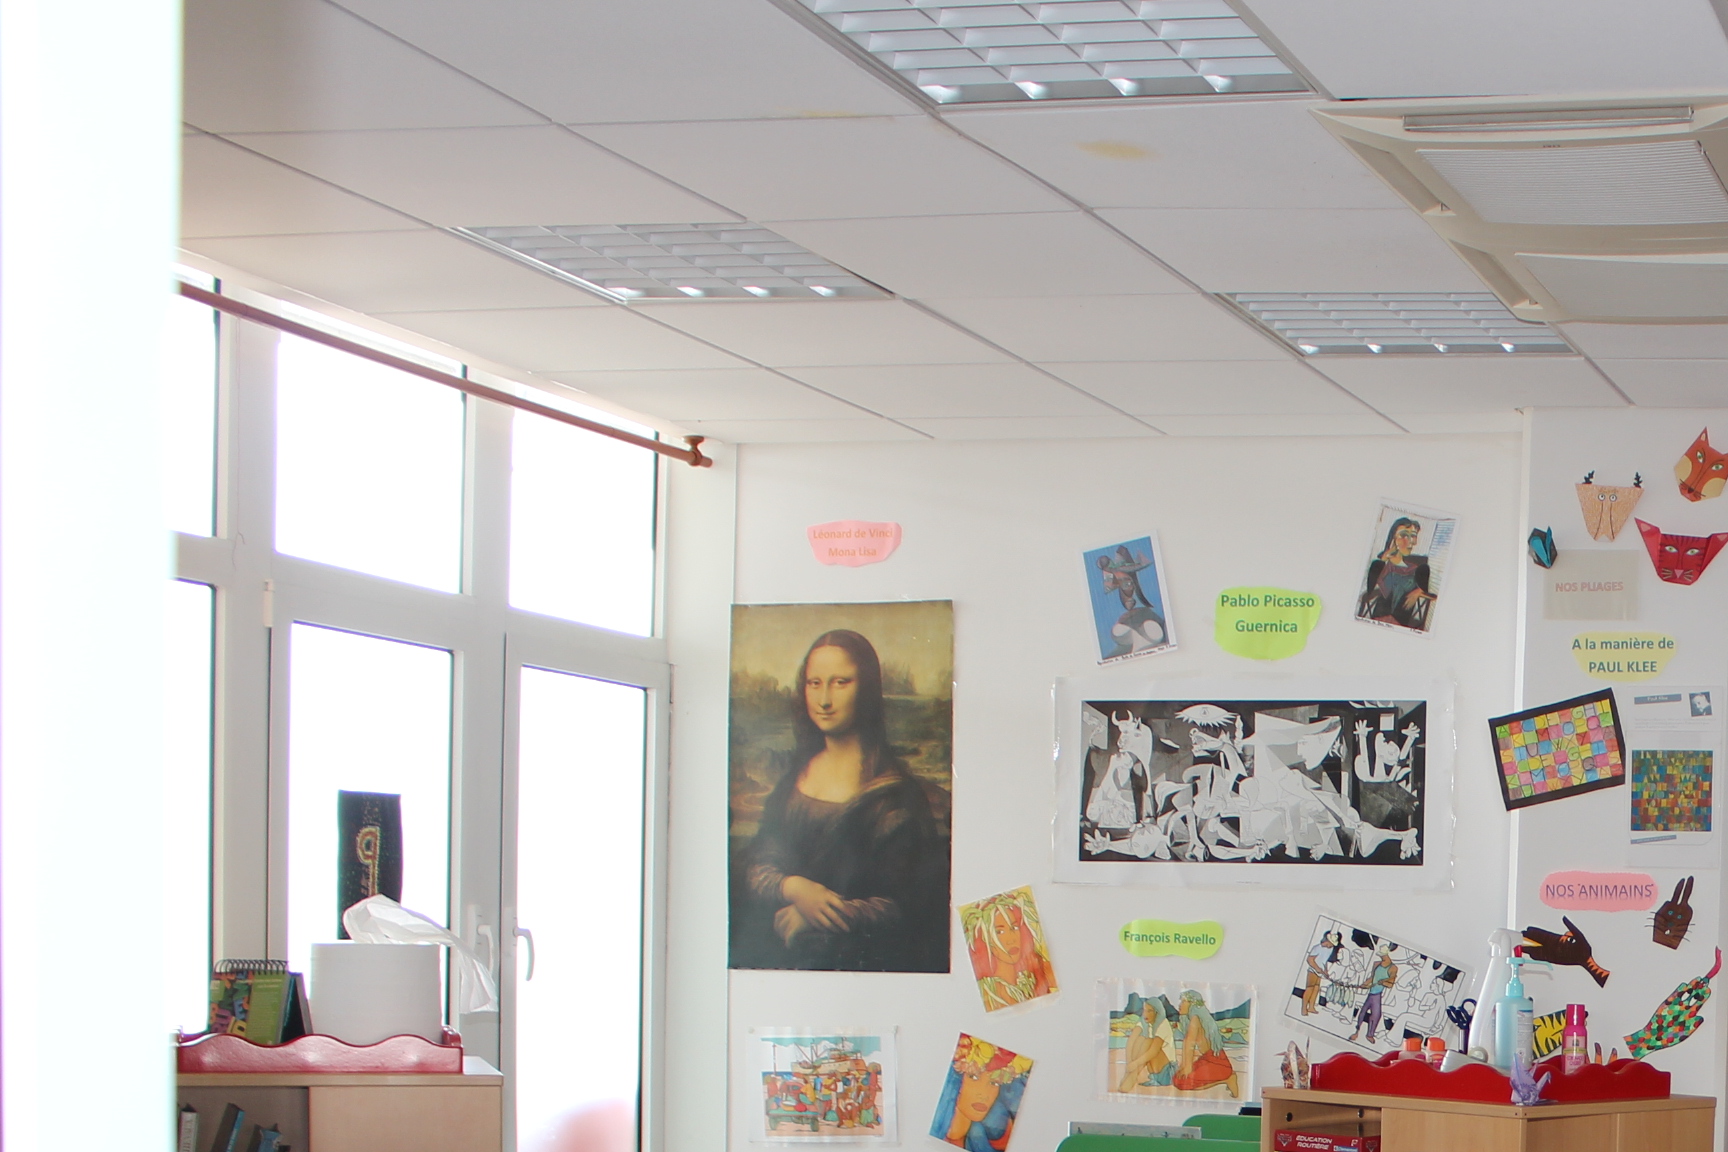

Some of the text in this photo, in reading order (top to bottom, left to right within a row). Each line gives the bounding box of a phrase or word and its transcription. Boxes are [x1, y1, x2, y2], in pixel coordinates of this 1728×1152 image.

[813, 528, 893, 539] Léonard de Vinci
[828, 547, 877, 557] Mona Lisa
[1555, 581, 1624, 592] NOS PLIAGES
[1221, 594, 1315, 608] Pablo Picasso
[1235, 619, 1298, 633] Guernica
[1572, 637, 1675, 650] A la manière de
[1588, 661, 1658, 673] PAUL KLEE
[1545, 884, 1575, 898] NOS
[1123, 930, 1217, 945] François Ravello
